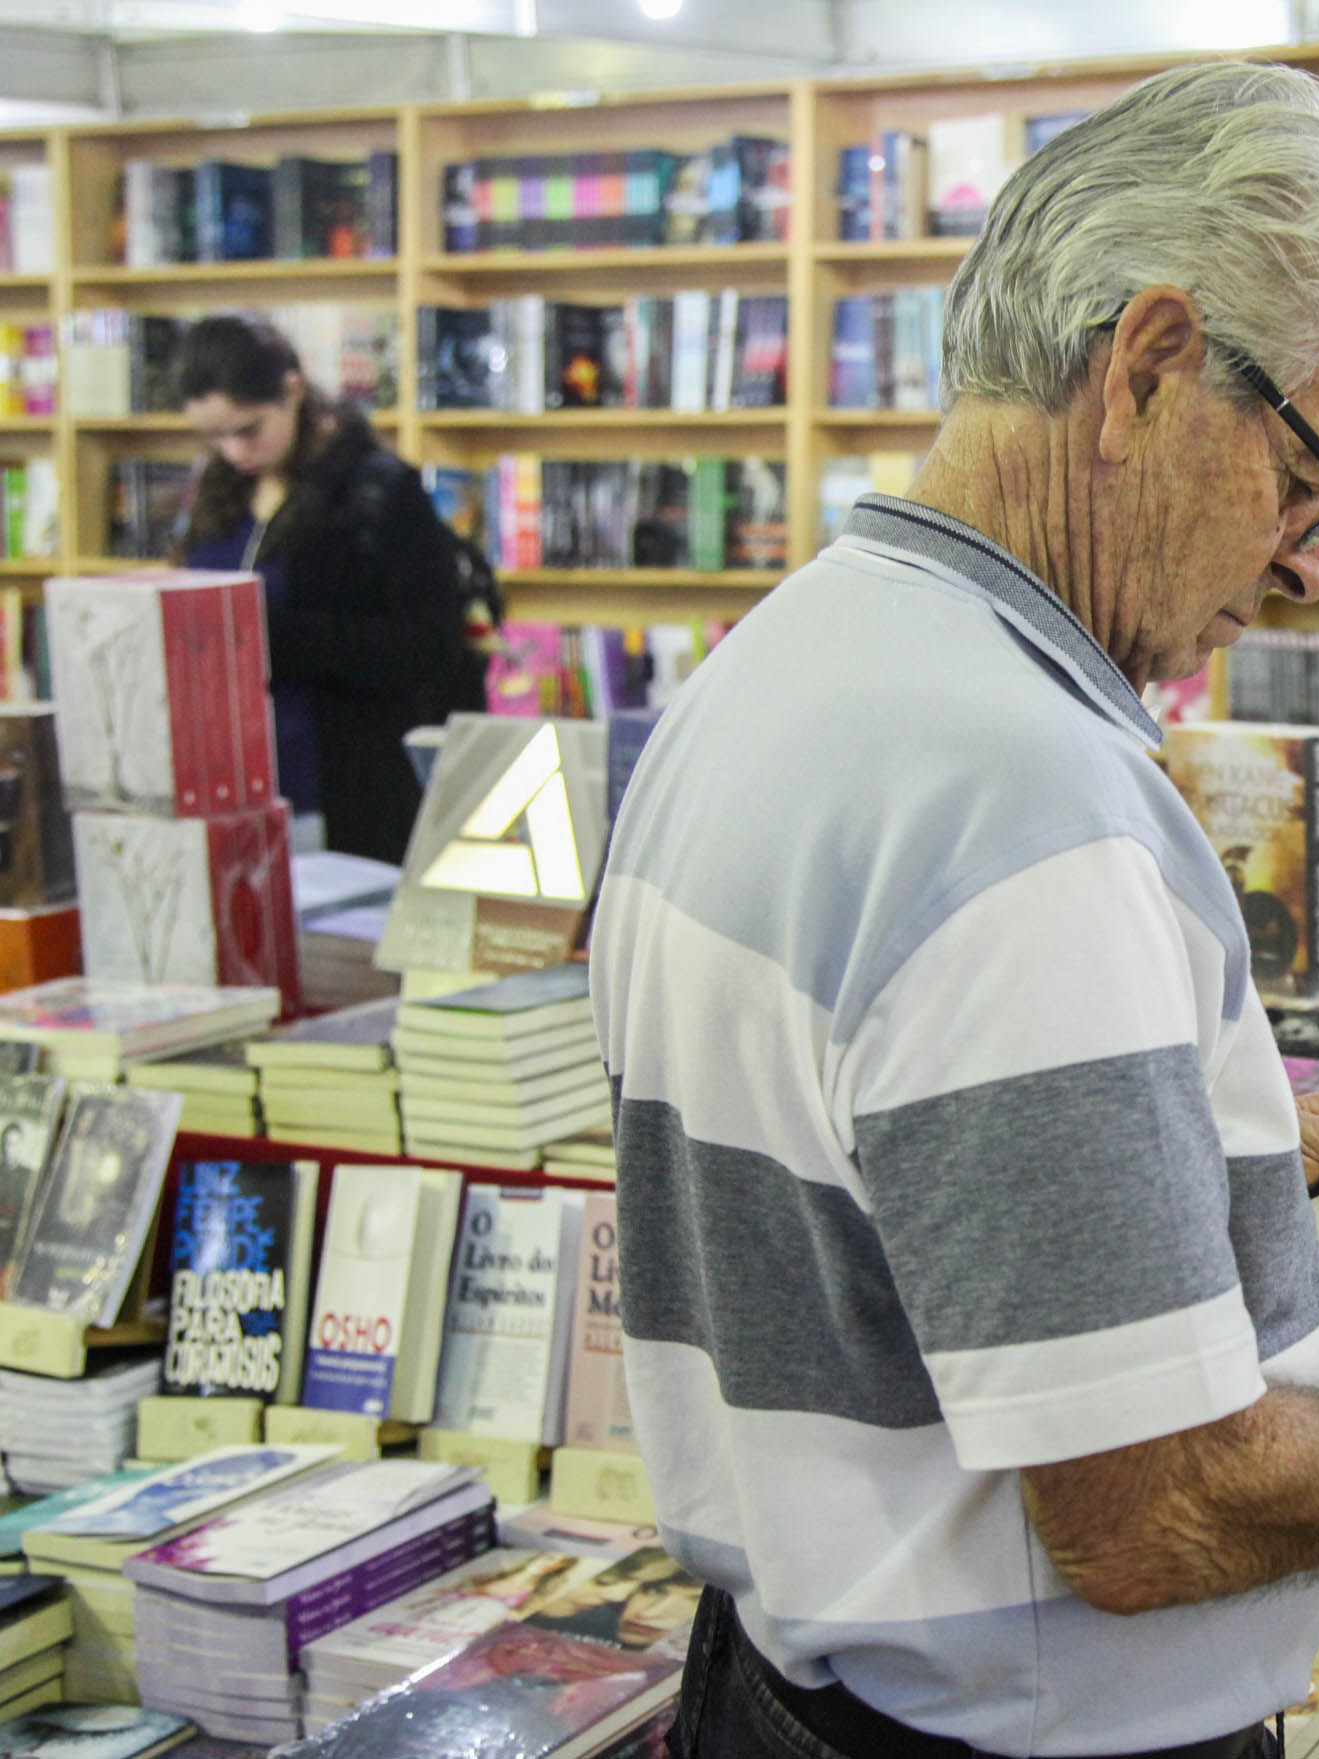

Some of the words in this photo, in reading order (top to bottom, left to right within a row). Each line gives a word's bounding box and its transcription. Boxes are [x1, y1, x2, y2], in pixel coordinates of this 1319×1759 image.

[470, 1209, 492, 1237] O
[464, 1243, 522, 1271] Livro
[319, 1313, 392, 1352] OSHO
